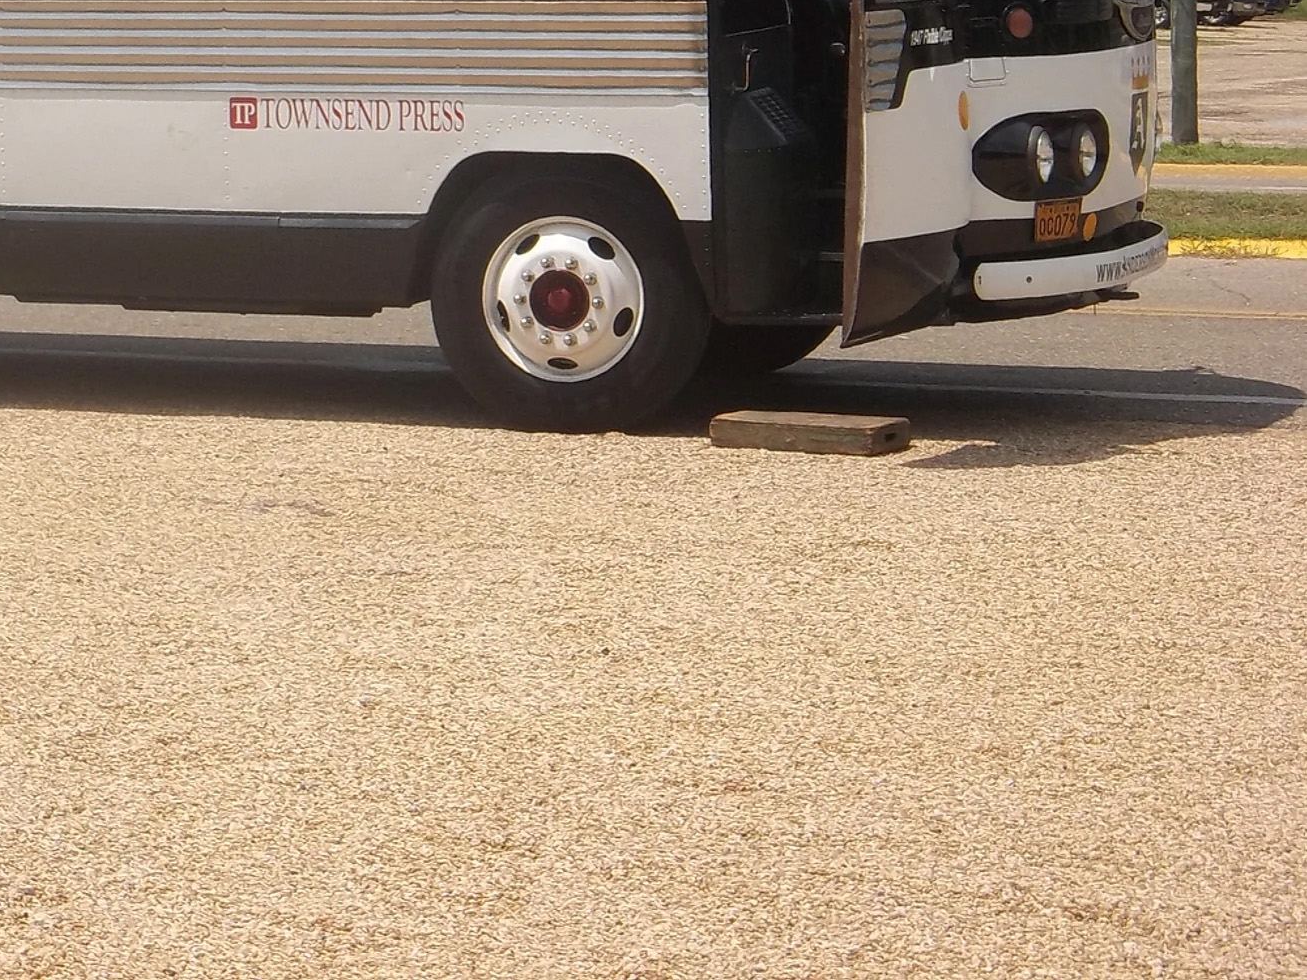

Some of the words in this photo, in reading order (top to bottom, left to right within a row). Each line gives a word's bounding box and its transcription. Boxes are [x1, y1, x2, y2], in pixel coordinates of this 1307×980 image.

[231, 103, 255, 125] TP
[260, 98, 391, 131] TOWNSEND
[398, 99, 465, 132] PRESS
